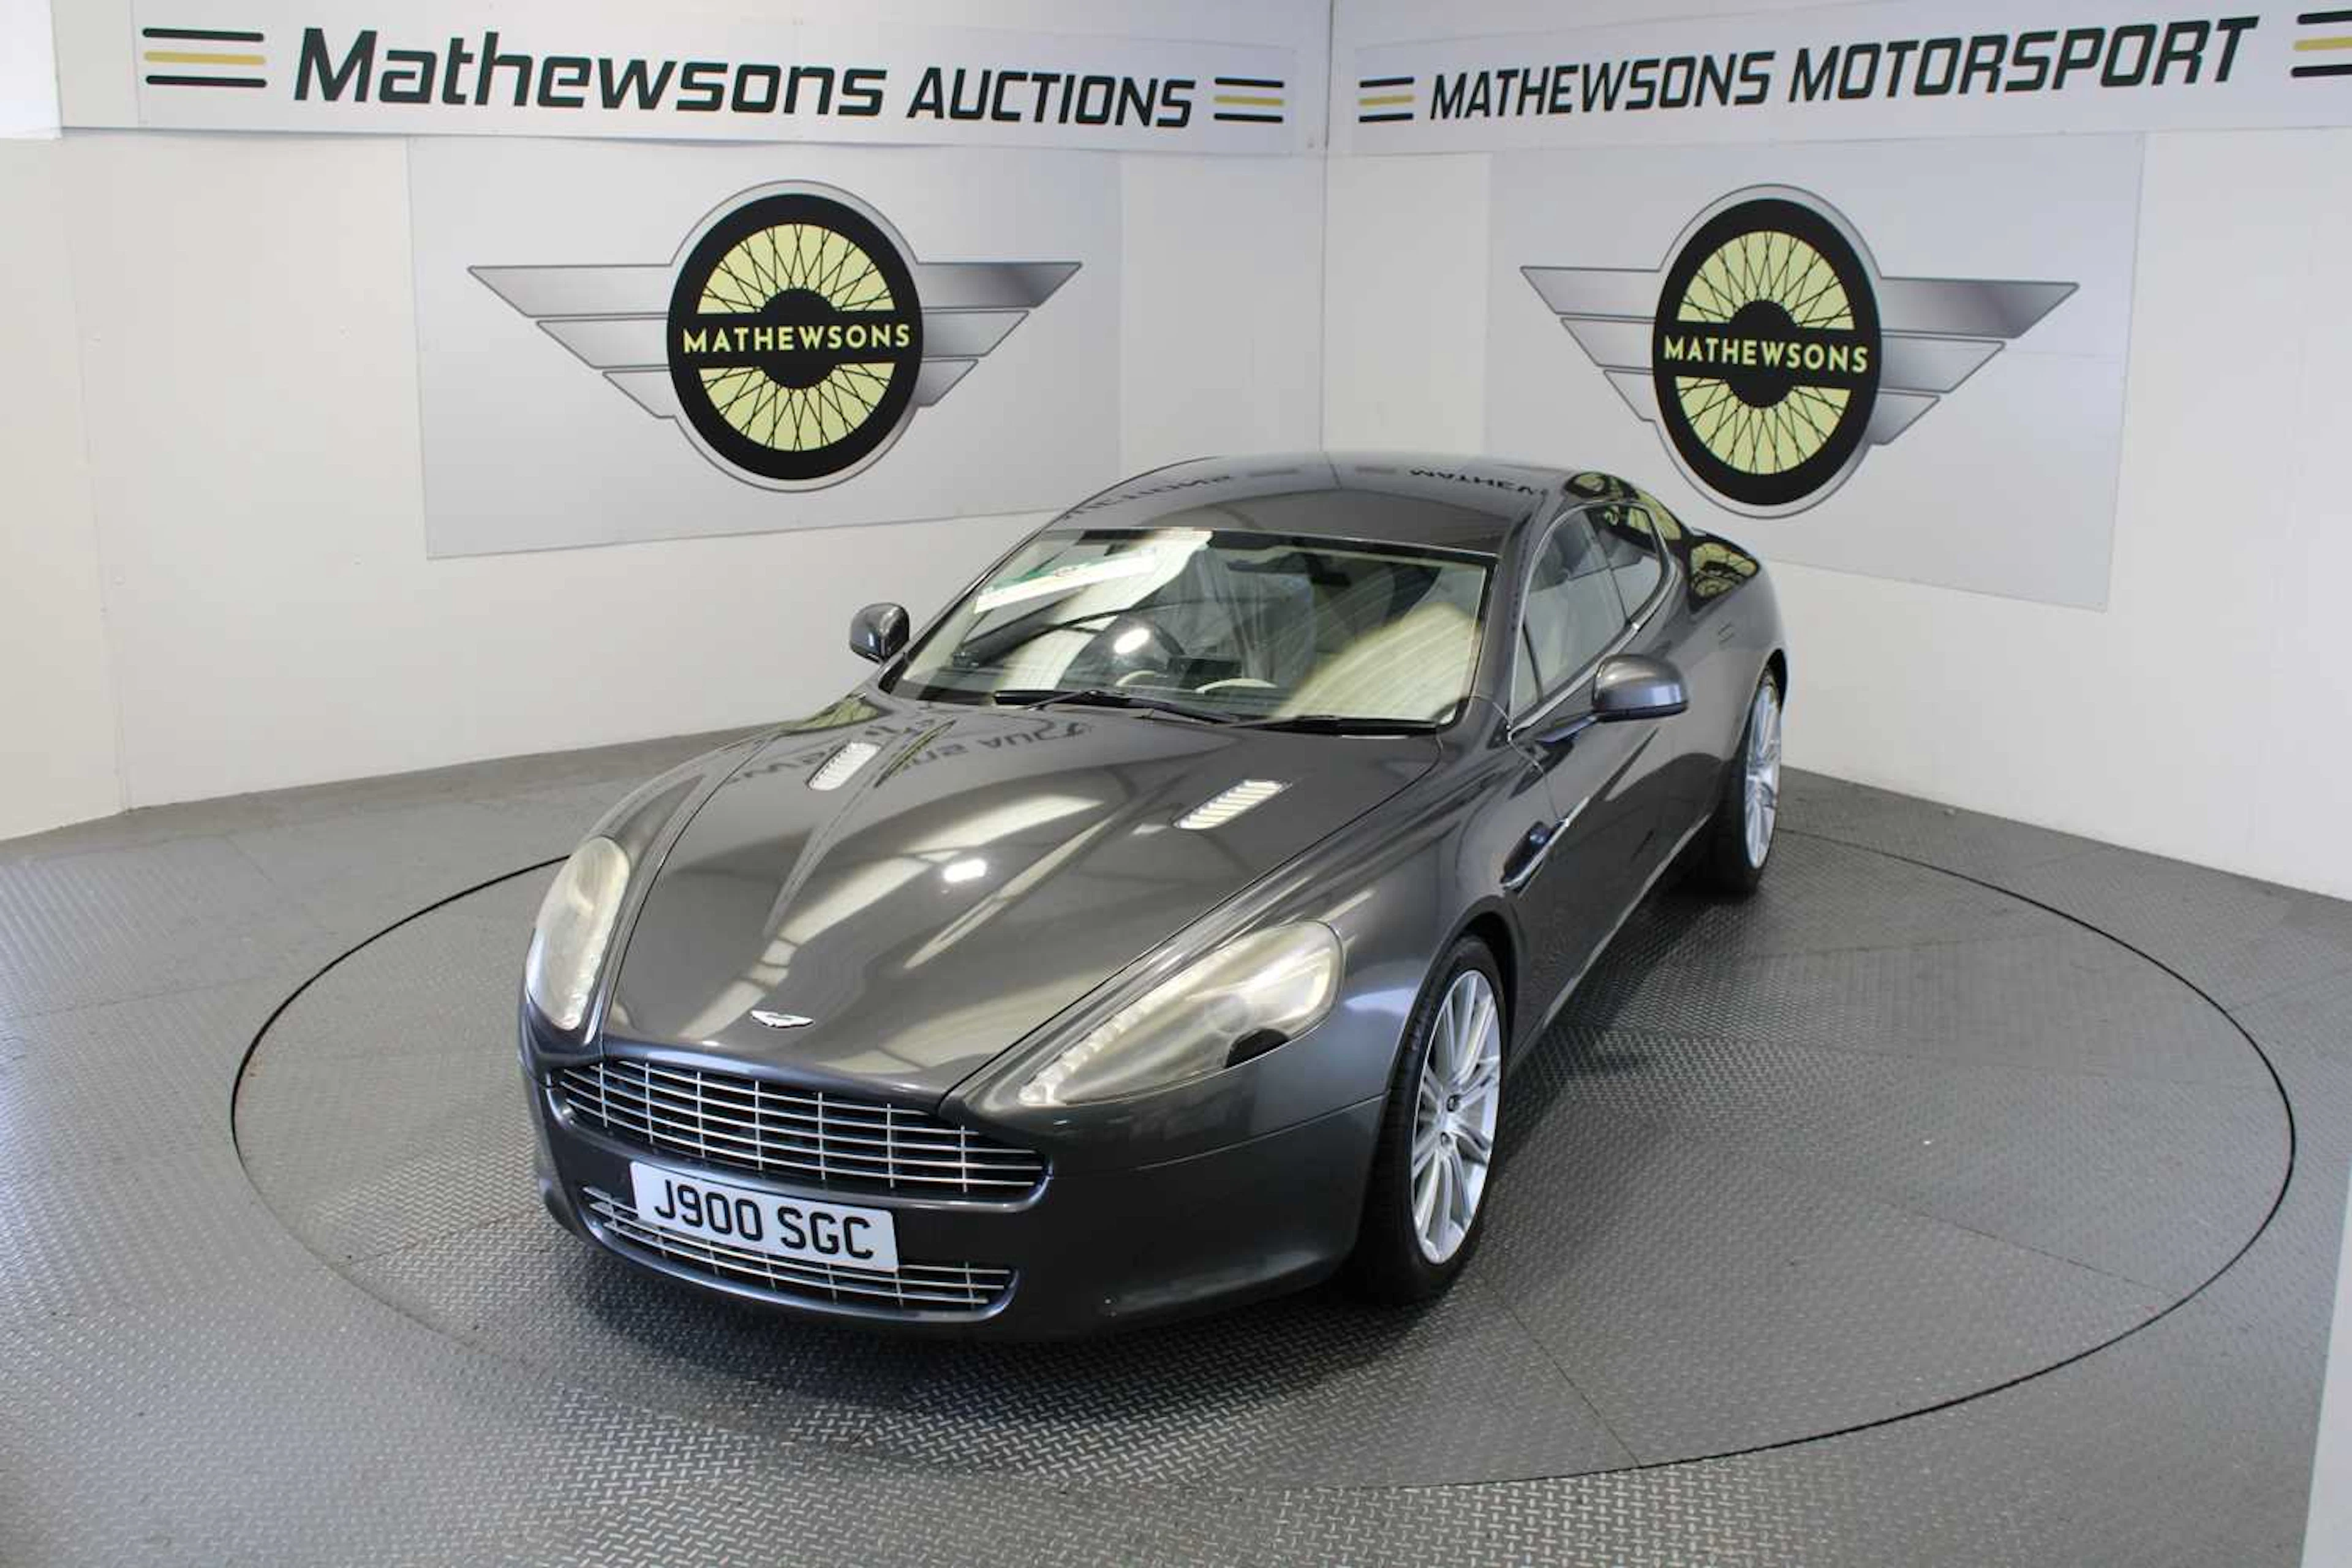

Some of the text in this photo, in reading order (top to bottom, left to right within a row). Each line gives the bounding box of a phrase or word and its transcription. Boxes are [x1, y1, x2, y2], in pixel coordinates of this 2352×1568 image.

[294, 28, 1196, 129] Mathewsons AUCTIONS
[1430, 15, 2260, 121] MATHEWSONS MOTORSPORT
[682, 323, 910, 353] MATHEWSONS
[1664, 335, 1868, 373] MATHEWSONS
[654, 1179, 874, 1260] J900 SGC
